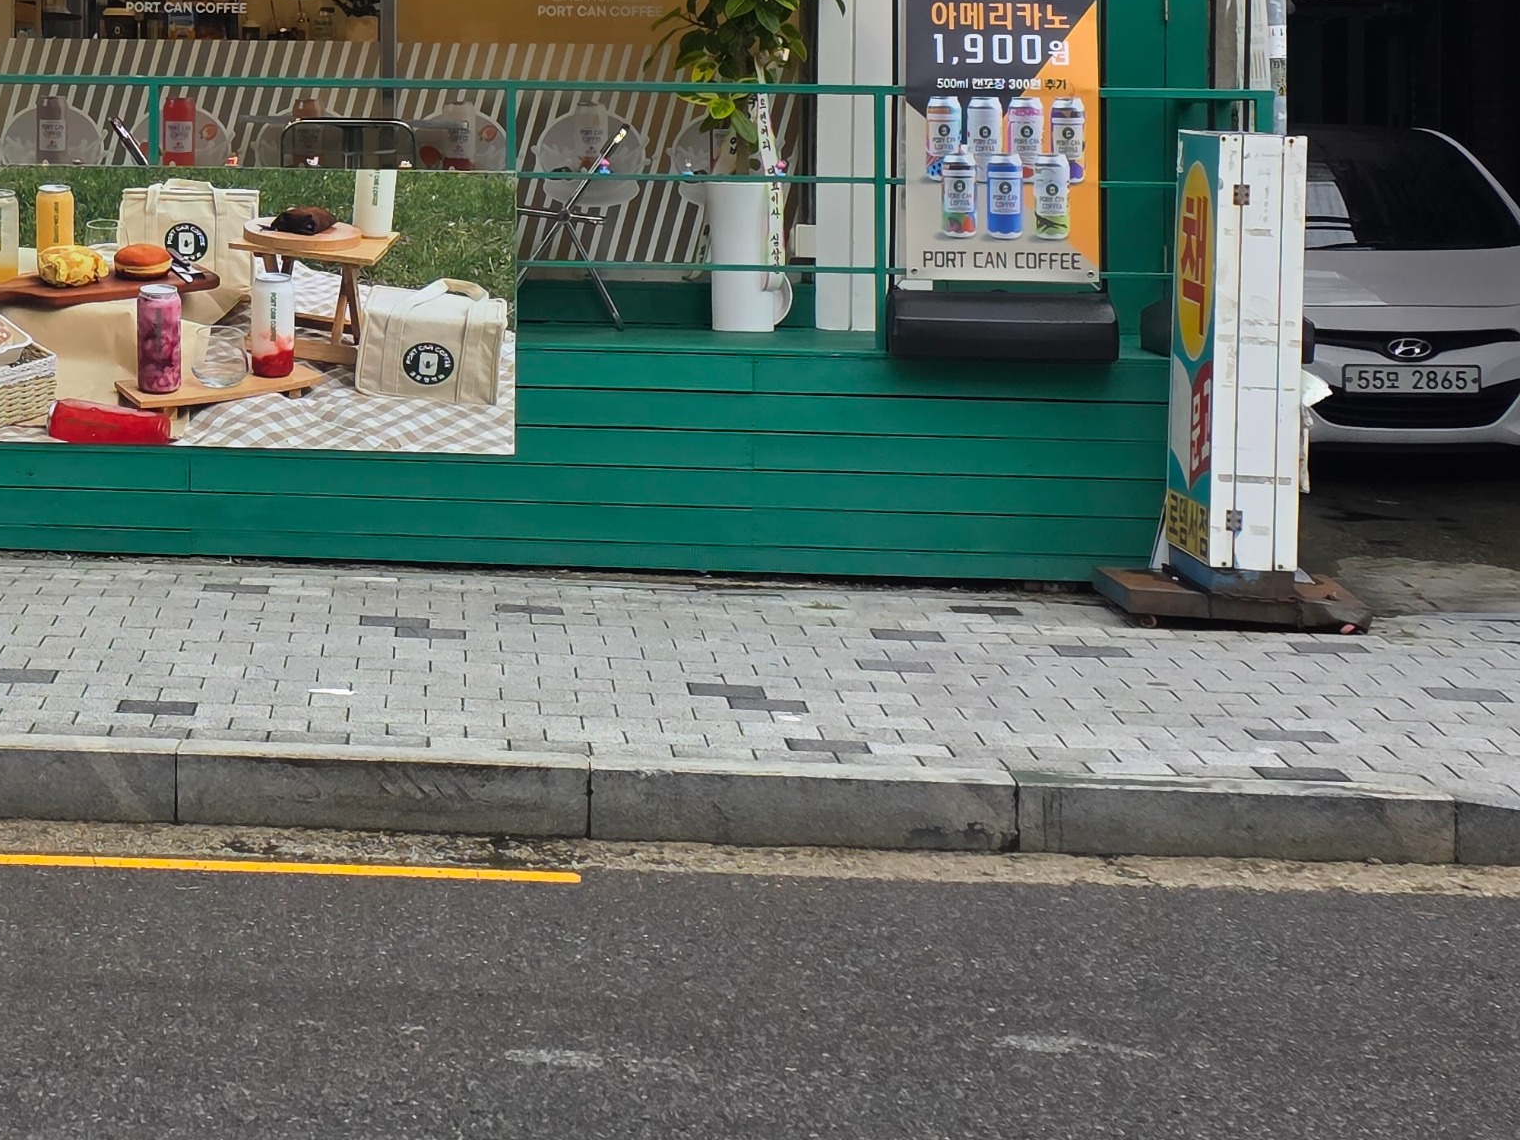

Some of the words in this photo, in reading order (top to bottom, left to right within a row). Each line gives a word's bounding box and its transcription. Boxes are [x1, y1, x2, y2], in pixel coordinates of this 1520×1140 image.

[125, 1, 162, 13] PORT
[164, 2, 193, 14] CAN
[195, 2, 248, 14] COFFEE
[537, 5, 574, 17] PORT
[577, 5, 606, 17] CAN
[609, 5, 664, 18] COFFEE
[931, 2, 1071, 30] 아메리카노
[933, 33, 1070, 67] 1,900원
[936, 77, 969, 89] 500ml
[922, 250, 967, 270] PORT
[973, 251, 1010, 270] CAN
[1015, 251, 1082, 271] COFFEE
[1180, 195, 1209, 337] 책
[1357, 370, 1400, 390] 55모
[1412, 370, 1468, 390] 2865
